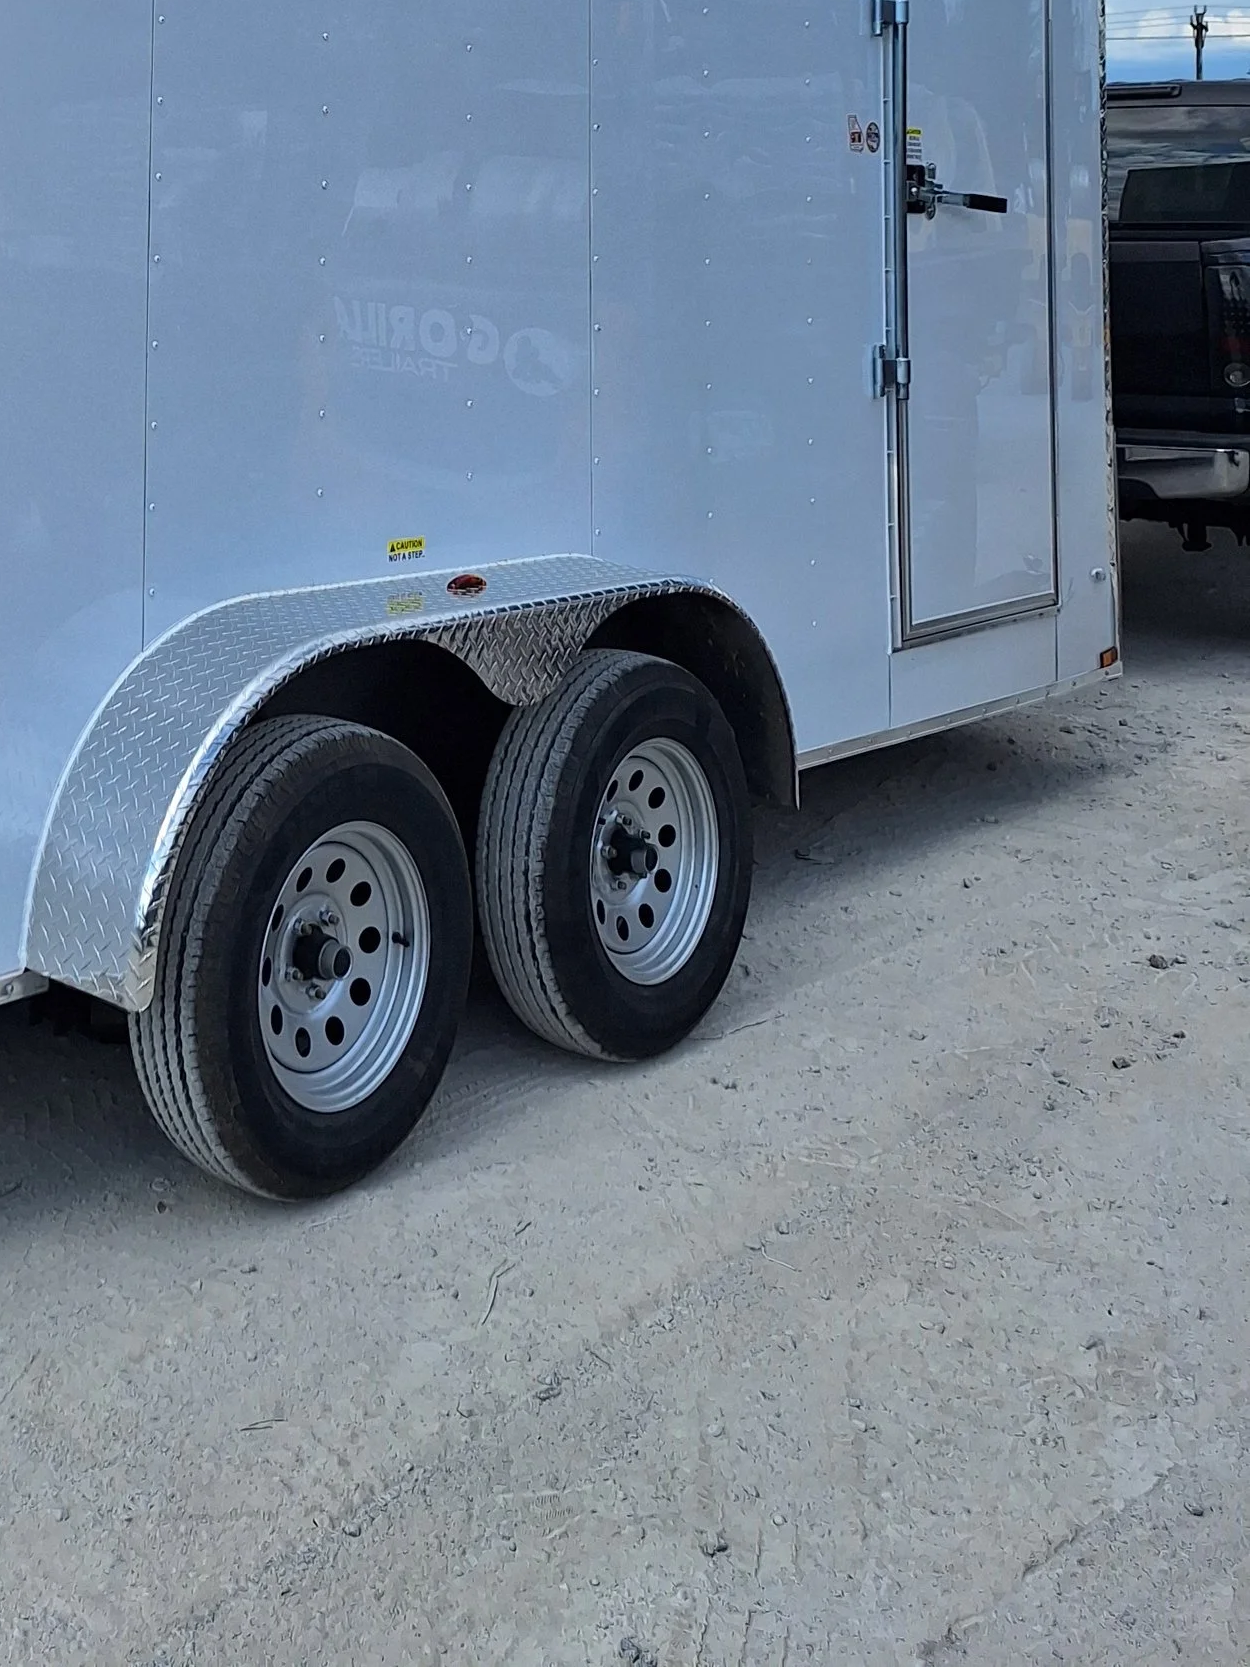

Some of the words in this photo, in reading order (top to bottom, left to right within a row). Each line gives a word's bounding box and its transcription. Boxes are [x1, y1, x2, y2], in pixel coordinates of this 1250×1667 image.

[396, 538, 423, 550] CAUTION
[388, 552, 401, 562] NOT
[402, 552, 407, 560] A
[408, 549, 423, 559] STEP
